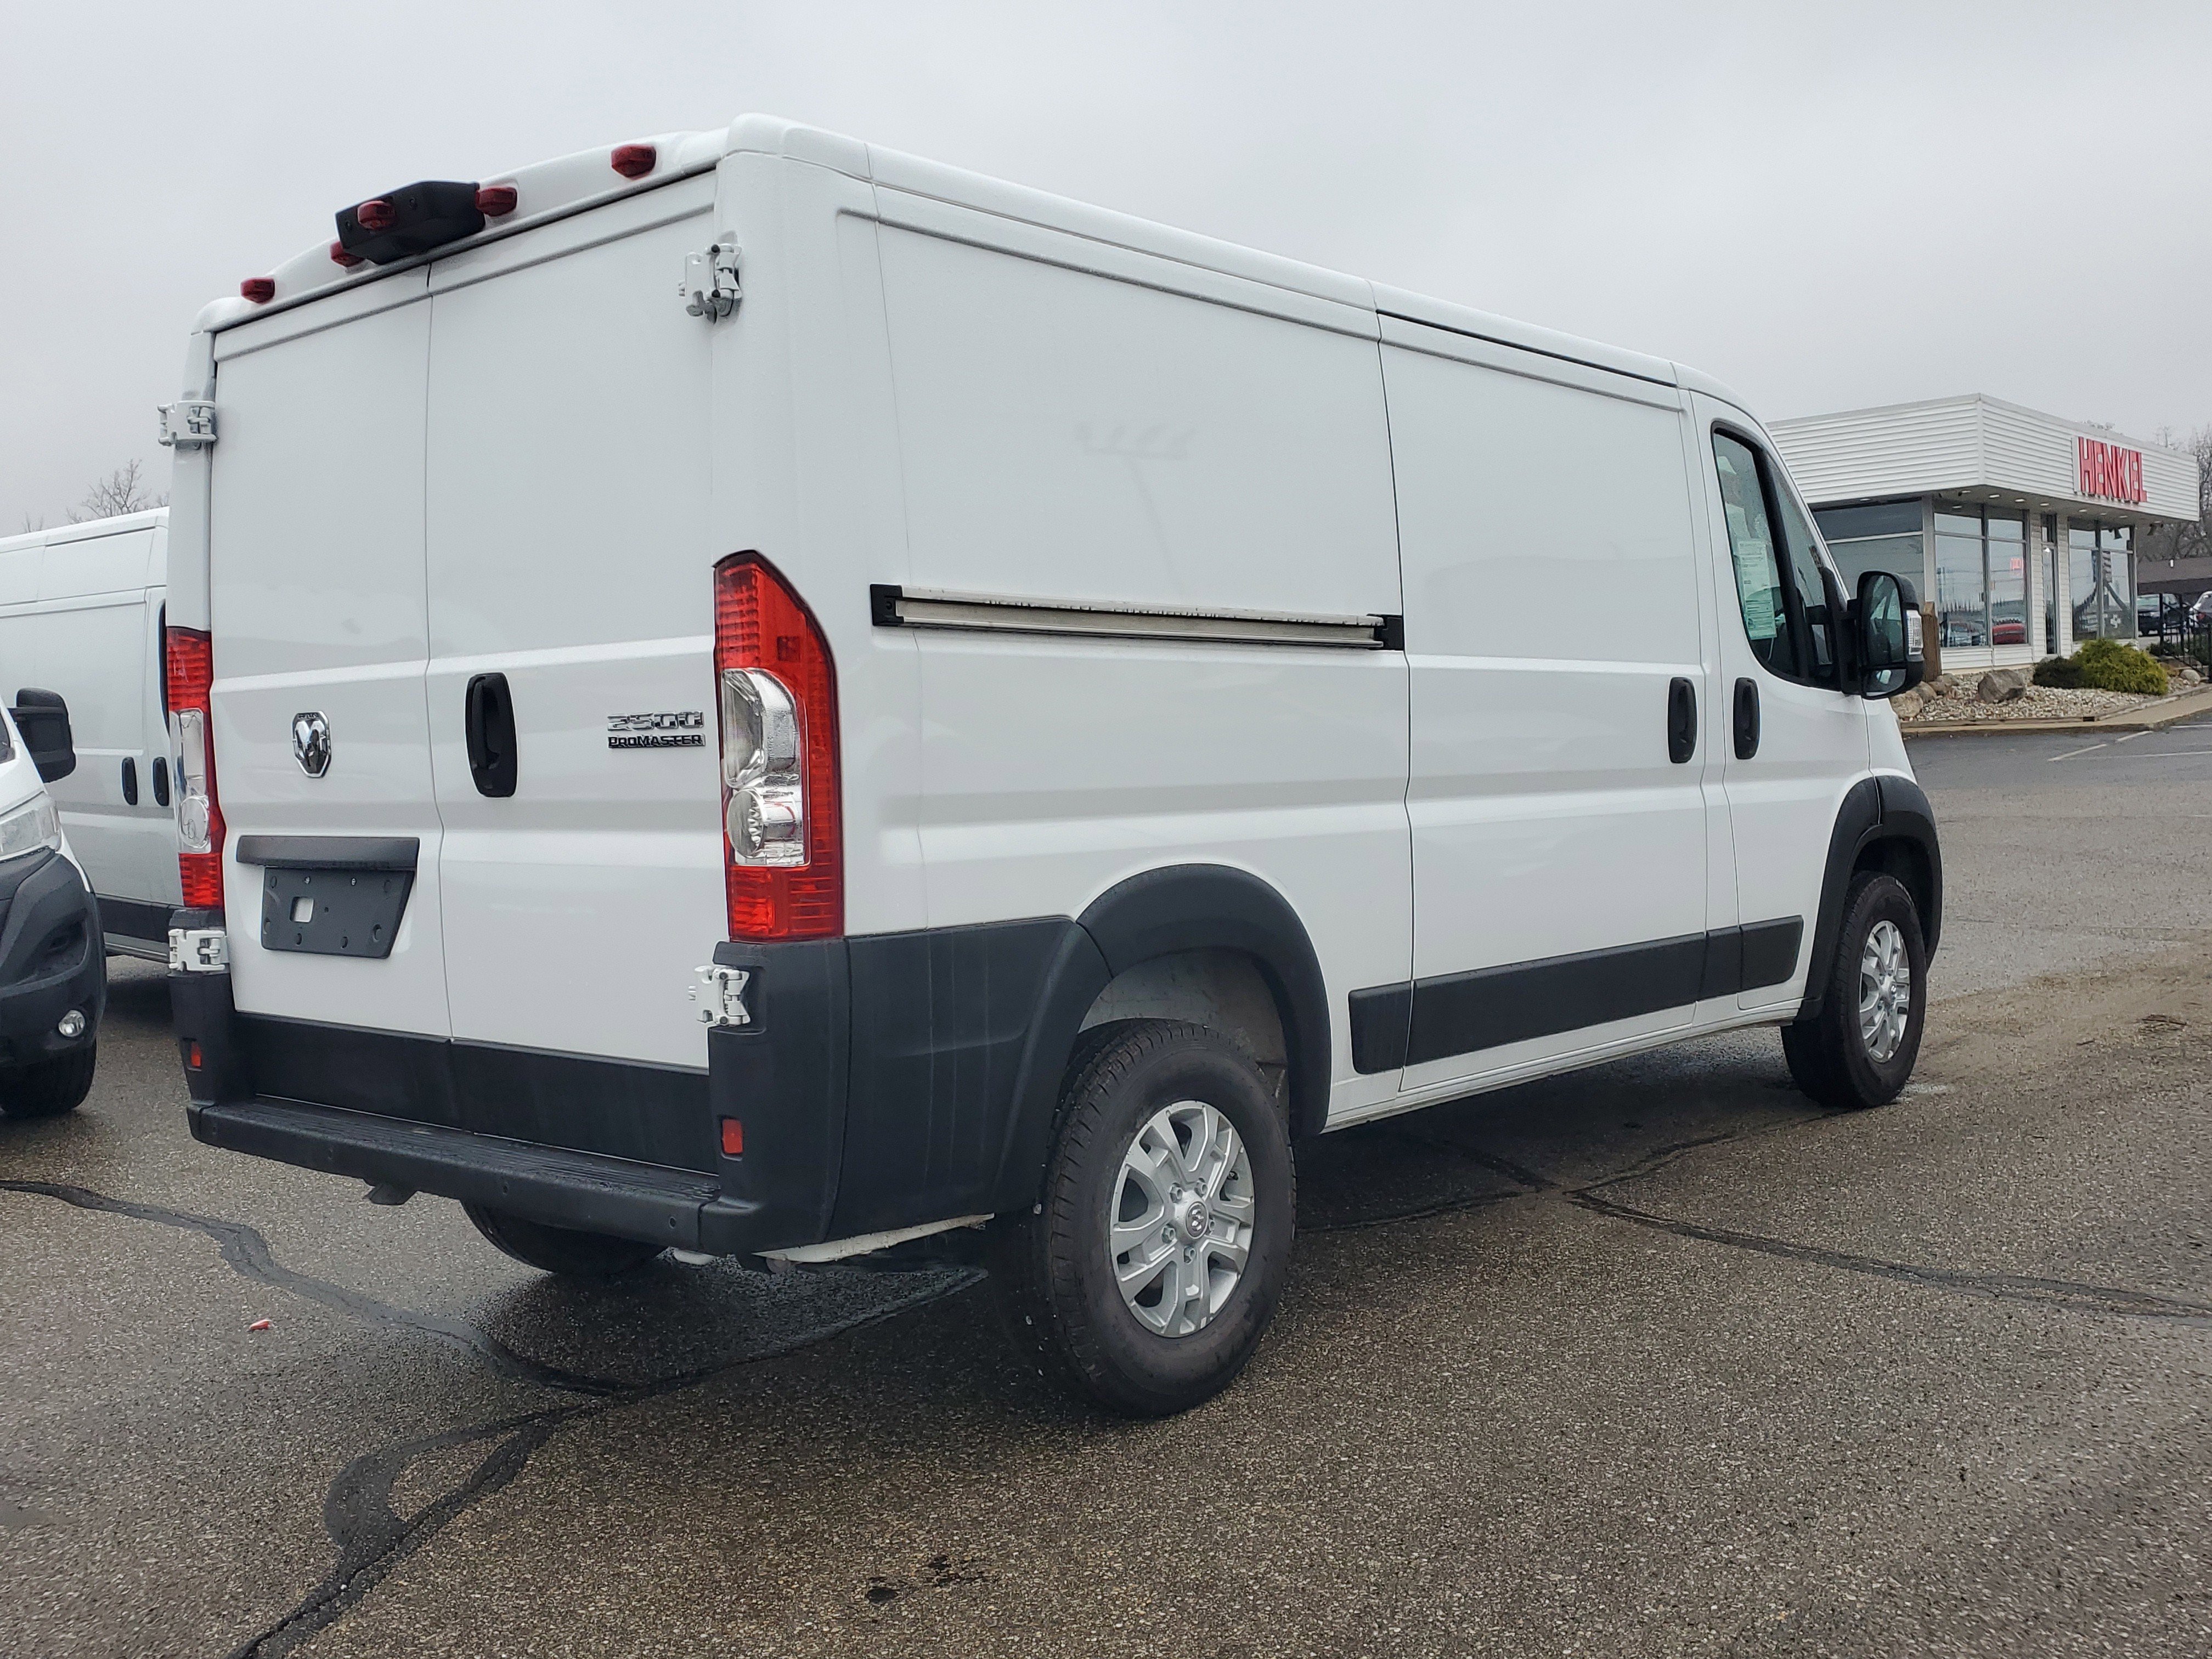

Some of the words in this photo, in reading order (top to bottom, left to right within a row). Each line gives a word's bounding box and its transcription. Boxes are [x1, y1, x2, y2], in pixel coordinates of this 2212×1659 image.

[2078, 436, 2147, 502] HENKEL
[607, 710, 704, 731] 2500
[608, 734, 706, 748] PROMASTER
